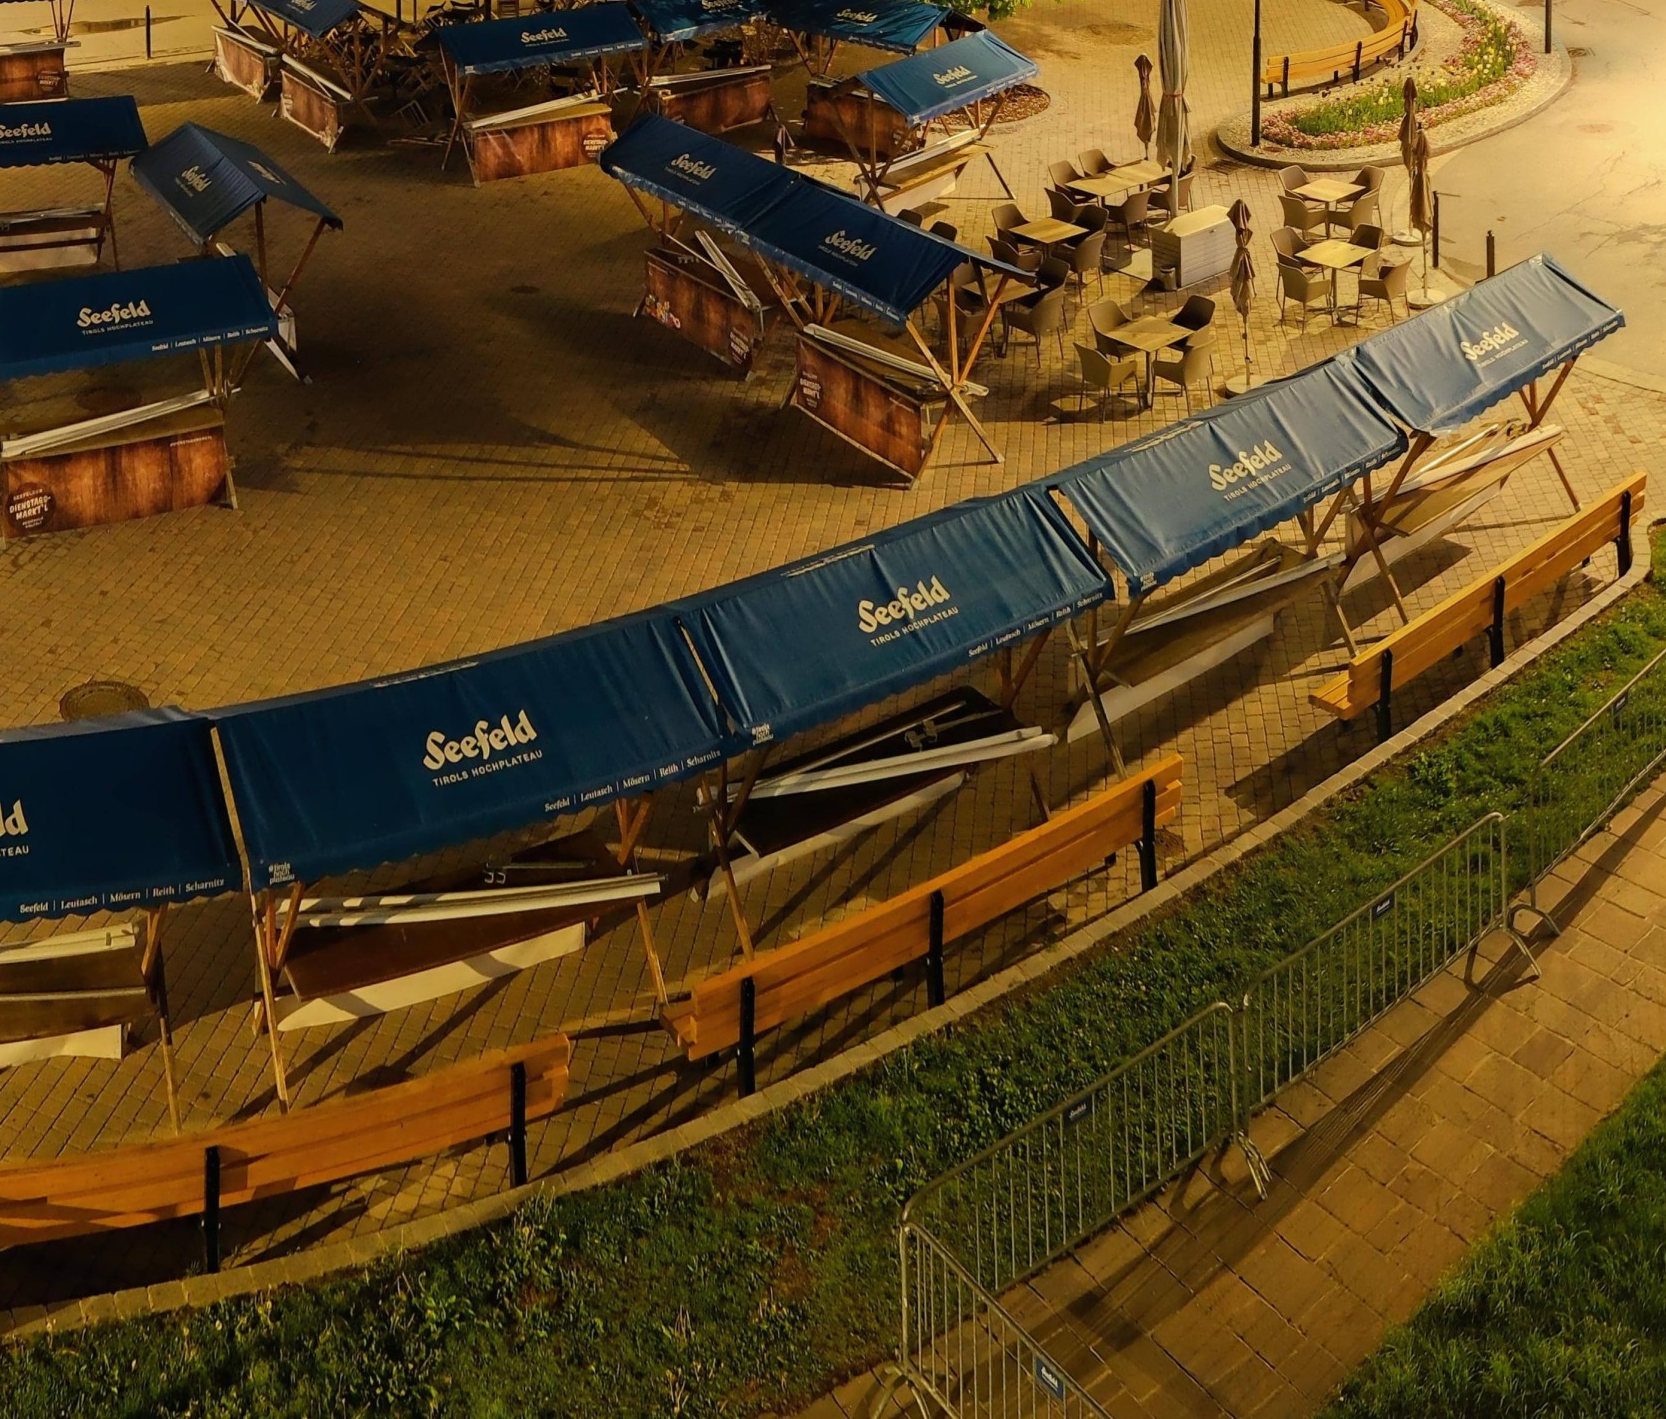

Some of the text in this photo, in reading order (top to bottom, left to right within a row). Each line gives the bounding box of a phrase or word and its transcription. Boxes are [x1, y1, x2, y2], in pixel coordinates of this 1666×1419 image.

[825, 230, 878, 261] Seefeld
[77, 299, 151, 328] Seefeld
[1459, 321, 1520, 362] Seefeld
[1208, 438, 1283, 492] Seefeld
[857, 575, 951, 634] Seefeld
[870, 606, 959, 648] TIROLS HOCHPLATEAU
[423, 709, 537, 770] Seefeld
[433, 749, 543, 788] TIROLS HOCHPLATEAU
[544, 797, 570, 813] Seefeld
[580, 784, 614, 802] Leutasch
[659, 762, 679, 778] Reith
[19, 900, 49, 914] Seefeld
[60, 894, 98, 910] Leutasch
[152, 884, 175, 898] Reith
[185, 878, 225, 893] Scharnitz
